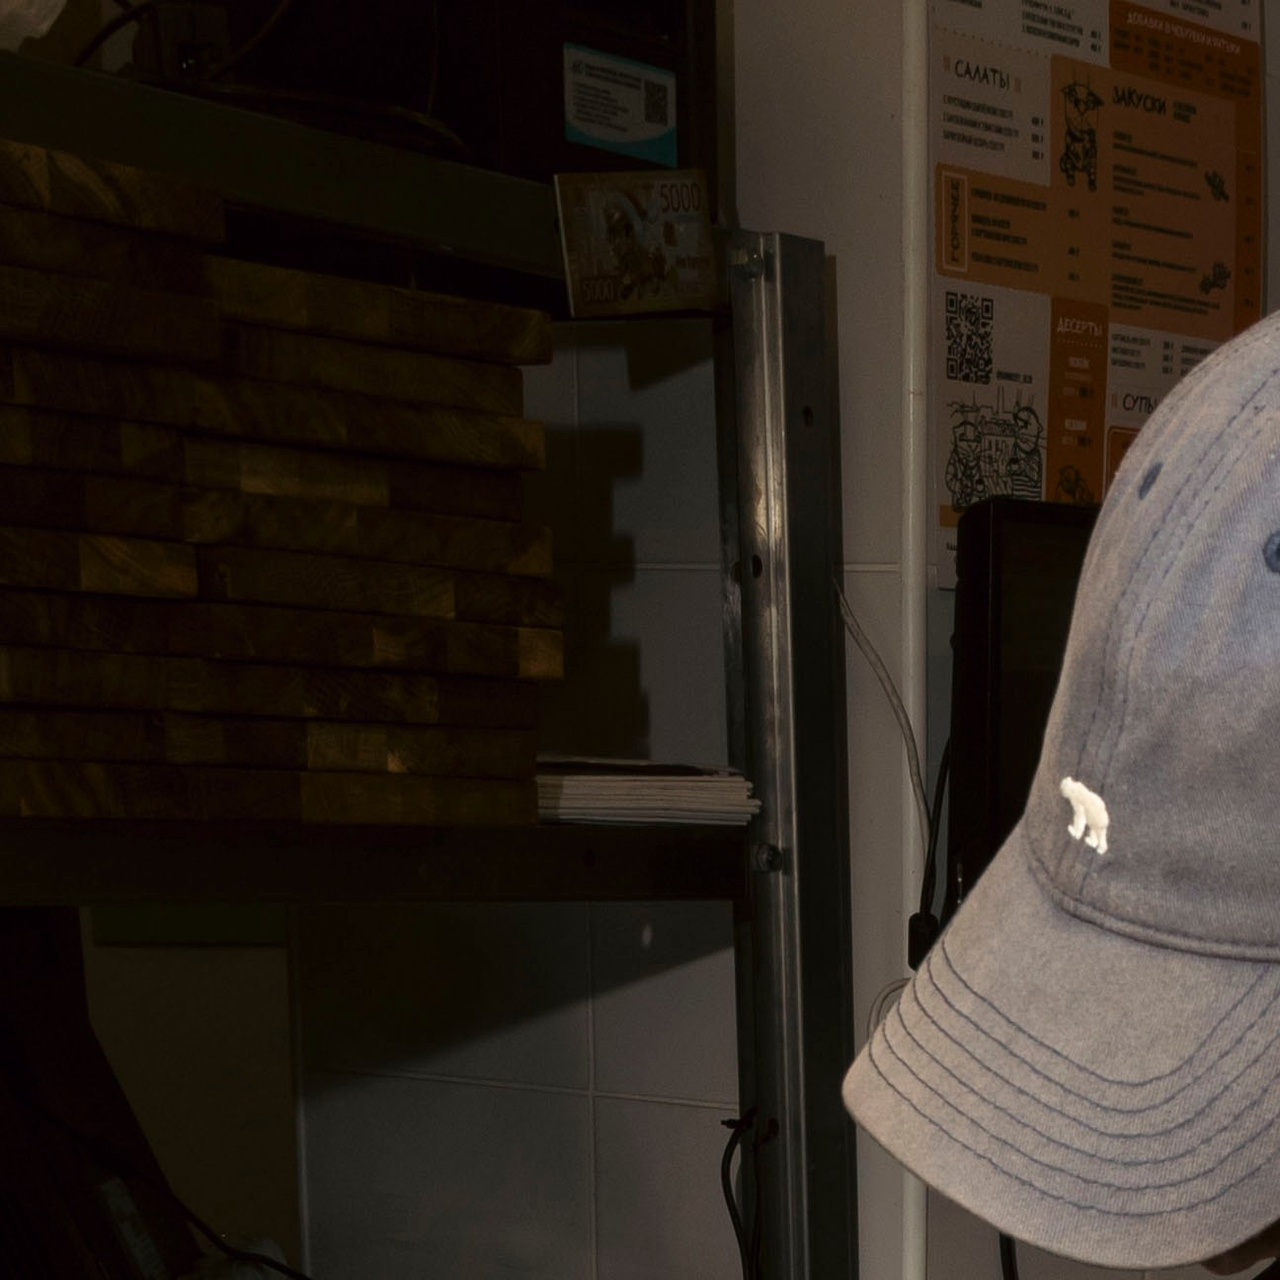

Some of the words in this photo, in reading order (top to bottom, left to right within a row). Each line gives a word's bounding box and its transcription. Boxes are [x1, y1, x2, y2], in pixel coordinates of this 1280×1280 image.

[955, 60, 1010, 90] САЛАТЫ
[1112, 86, 1167, 115] ЗАКУСКИ
[660, 182, 701, 213] 5000
[1057, 316, 1103, 337] ДЕСЕРТЫ
[1122, 393, 1157, 414] СУПЫ
